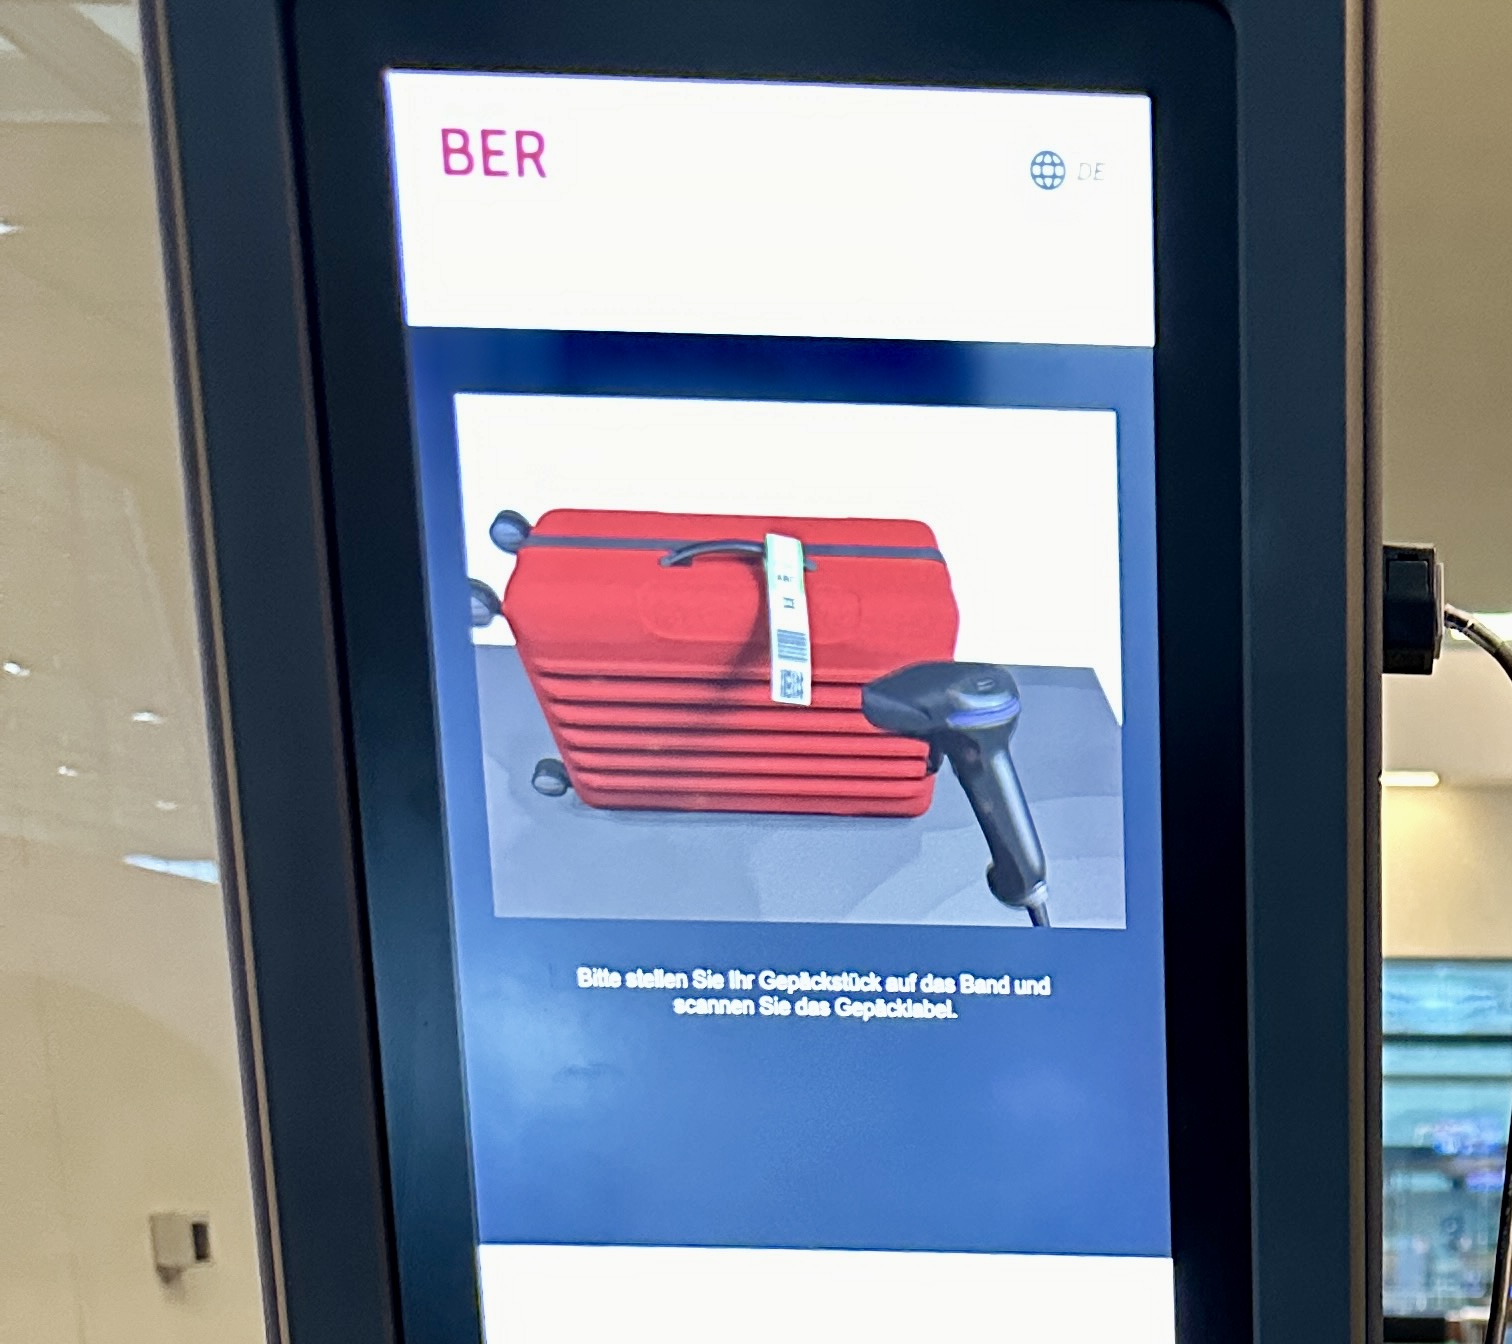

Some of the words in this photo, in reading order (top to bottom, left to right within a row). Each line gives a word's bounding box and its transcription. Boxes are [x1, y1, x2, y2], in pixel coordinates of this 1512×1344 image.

[440, 128, 547, 178] BER
[1077, 162, 1105, 181] DE
[576, 966, 622, 988] Bitte
[625, 968, 688, 989] stellen
[692, 969, 725, 989] Sie
[729, 970, 755, 990] Ihr
[759, 970, 882, 994] Gepäckstück
[886, 973, 918, 992] auf
[920, 973, 957, 993] das
[959, 974, 1010, 994] Band
[1014, 975, 1051, 995] und
[673, 998, 755, 1015] scannen
[759, 996, 791, 1016] Sie
[795, 997, 832, 1016] das
[834, 997, 958, 1021] Gepäcklabel.
